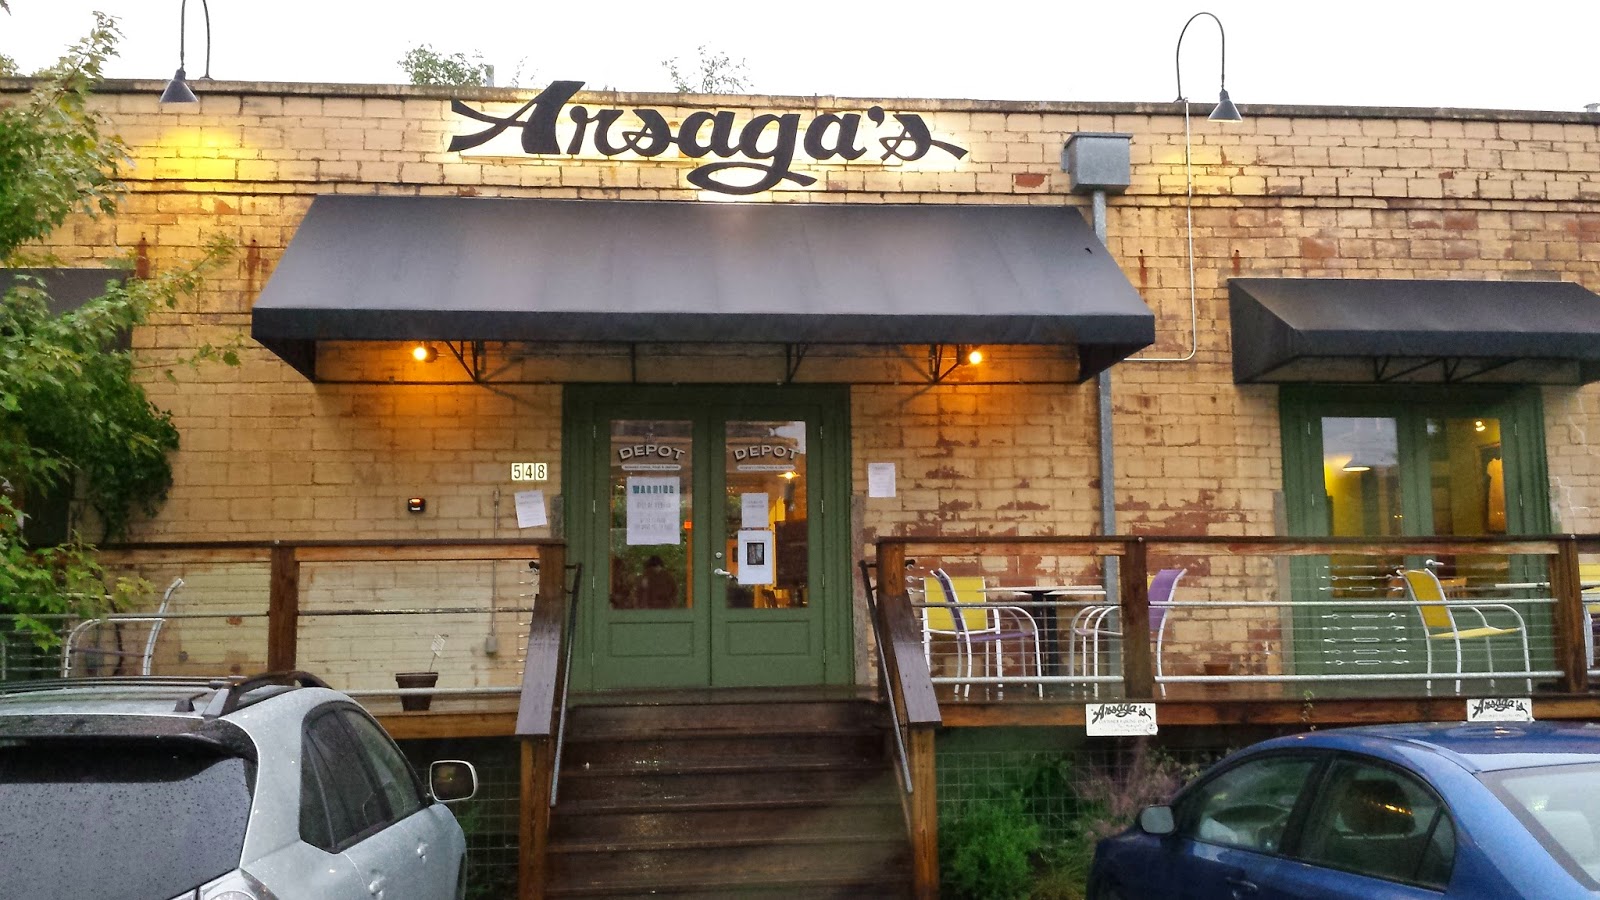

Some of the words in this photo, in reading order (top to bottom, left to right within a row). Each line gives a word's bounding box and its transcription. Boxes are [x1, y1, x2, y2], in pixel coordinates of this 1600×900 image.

[447, 80, 969, 195] Arsaga's
[618, 444, 686, 461] DEPOT
[734, 445, 802, 462] DEPOT
[513, 464, 545, 479] 548
[632, 485, 674, 494] WARNING
[1091, 703, 1152, 725] Arsaga's
[1471, 698, 1528, 719] Arsaga's
